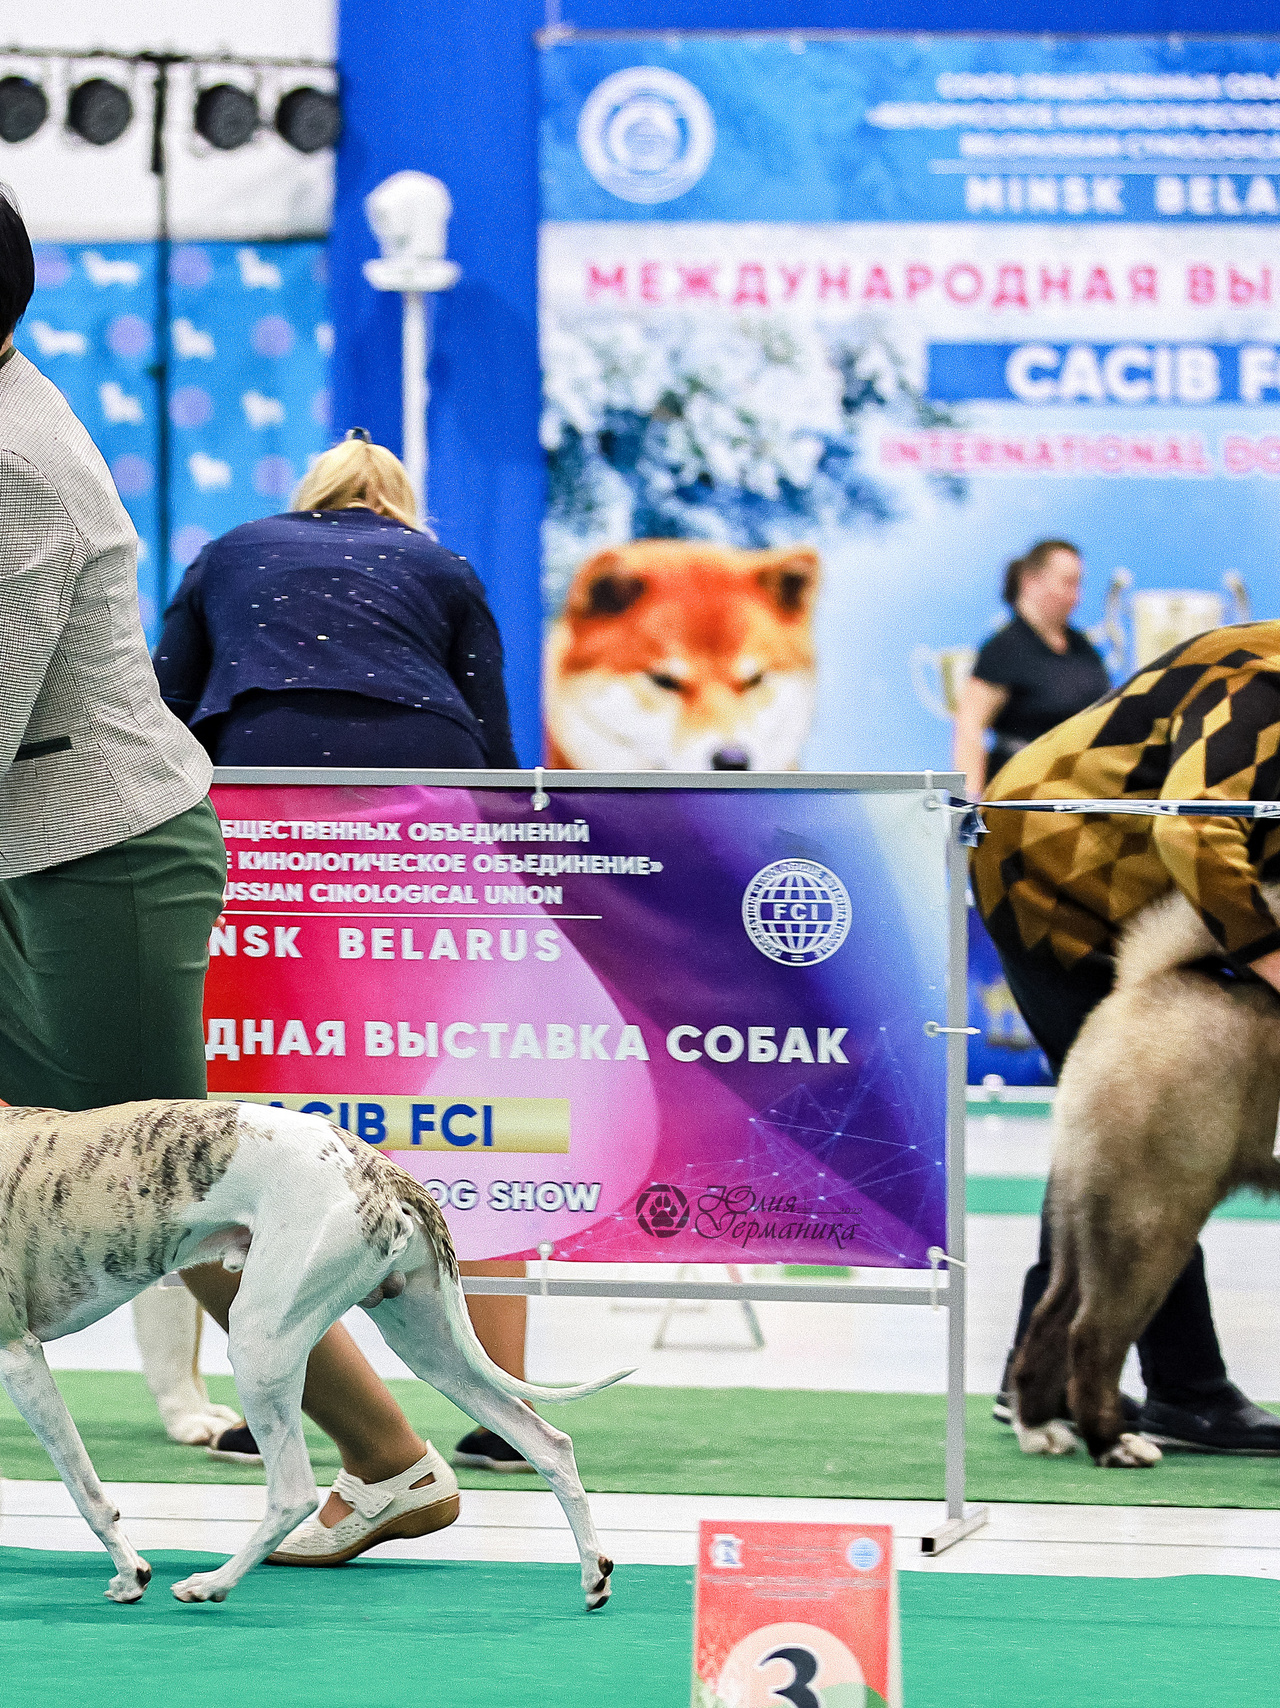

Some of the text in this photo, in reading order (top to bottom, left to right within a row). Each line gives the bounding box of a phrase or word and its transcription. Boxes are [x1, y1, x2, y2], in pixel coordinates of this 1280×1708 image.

[965, 174, 1125, 216] MINSK
[586, 261, 1273, 308] МЕЖДУНАРОДНАЯ ВЫ
[1006, 346, 1220, 402] CACIB
[407, 818, 590, 845] ОБЪЕДИНЕНИЙ
[238, 850, 467, 873] КИНОЛОГИЧЕСКОЕ
[472, 853, 665, 877] ОБЪЕДИНЕНИЕ»
[309, 883, 479, 905] CINOLOGICAL
[484, 885, 563, 905] UNION
[773, 902, 819, 921] FCI
[338, 926, 563, 962] BELARUS
[204, 1017, 851, 1064] ДНАЯ ВЫСТАВКА СОБАК
[410, 1102, 494, 1148] FCI
[486, 1179, 601, 1212] SHOW
[756, 1643, 822, 1708] 3
